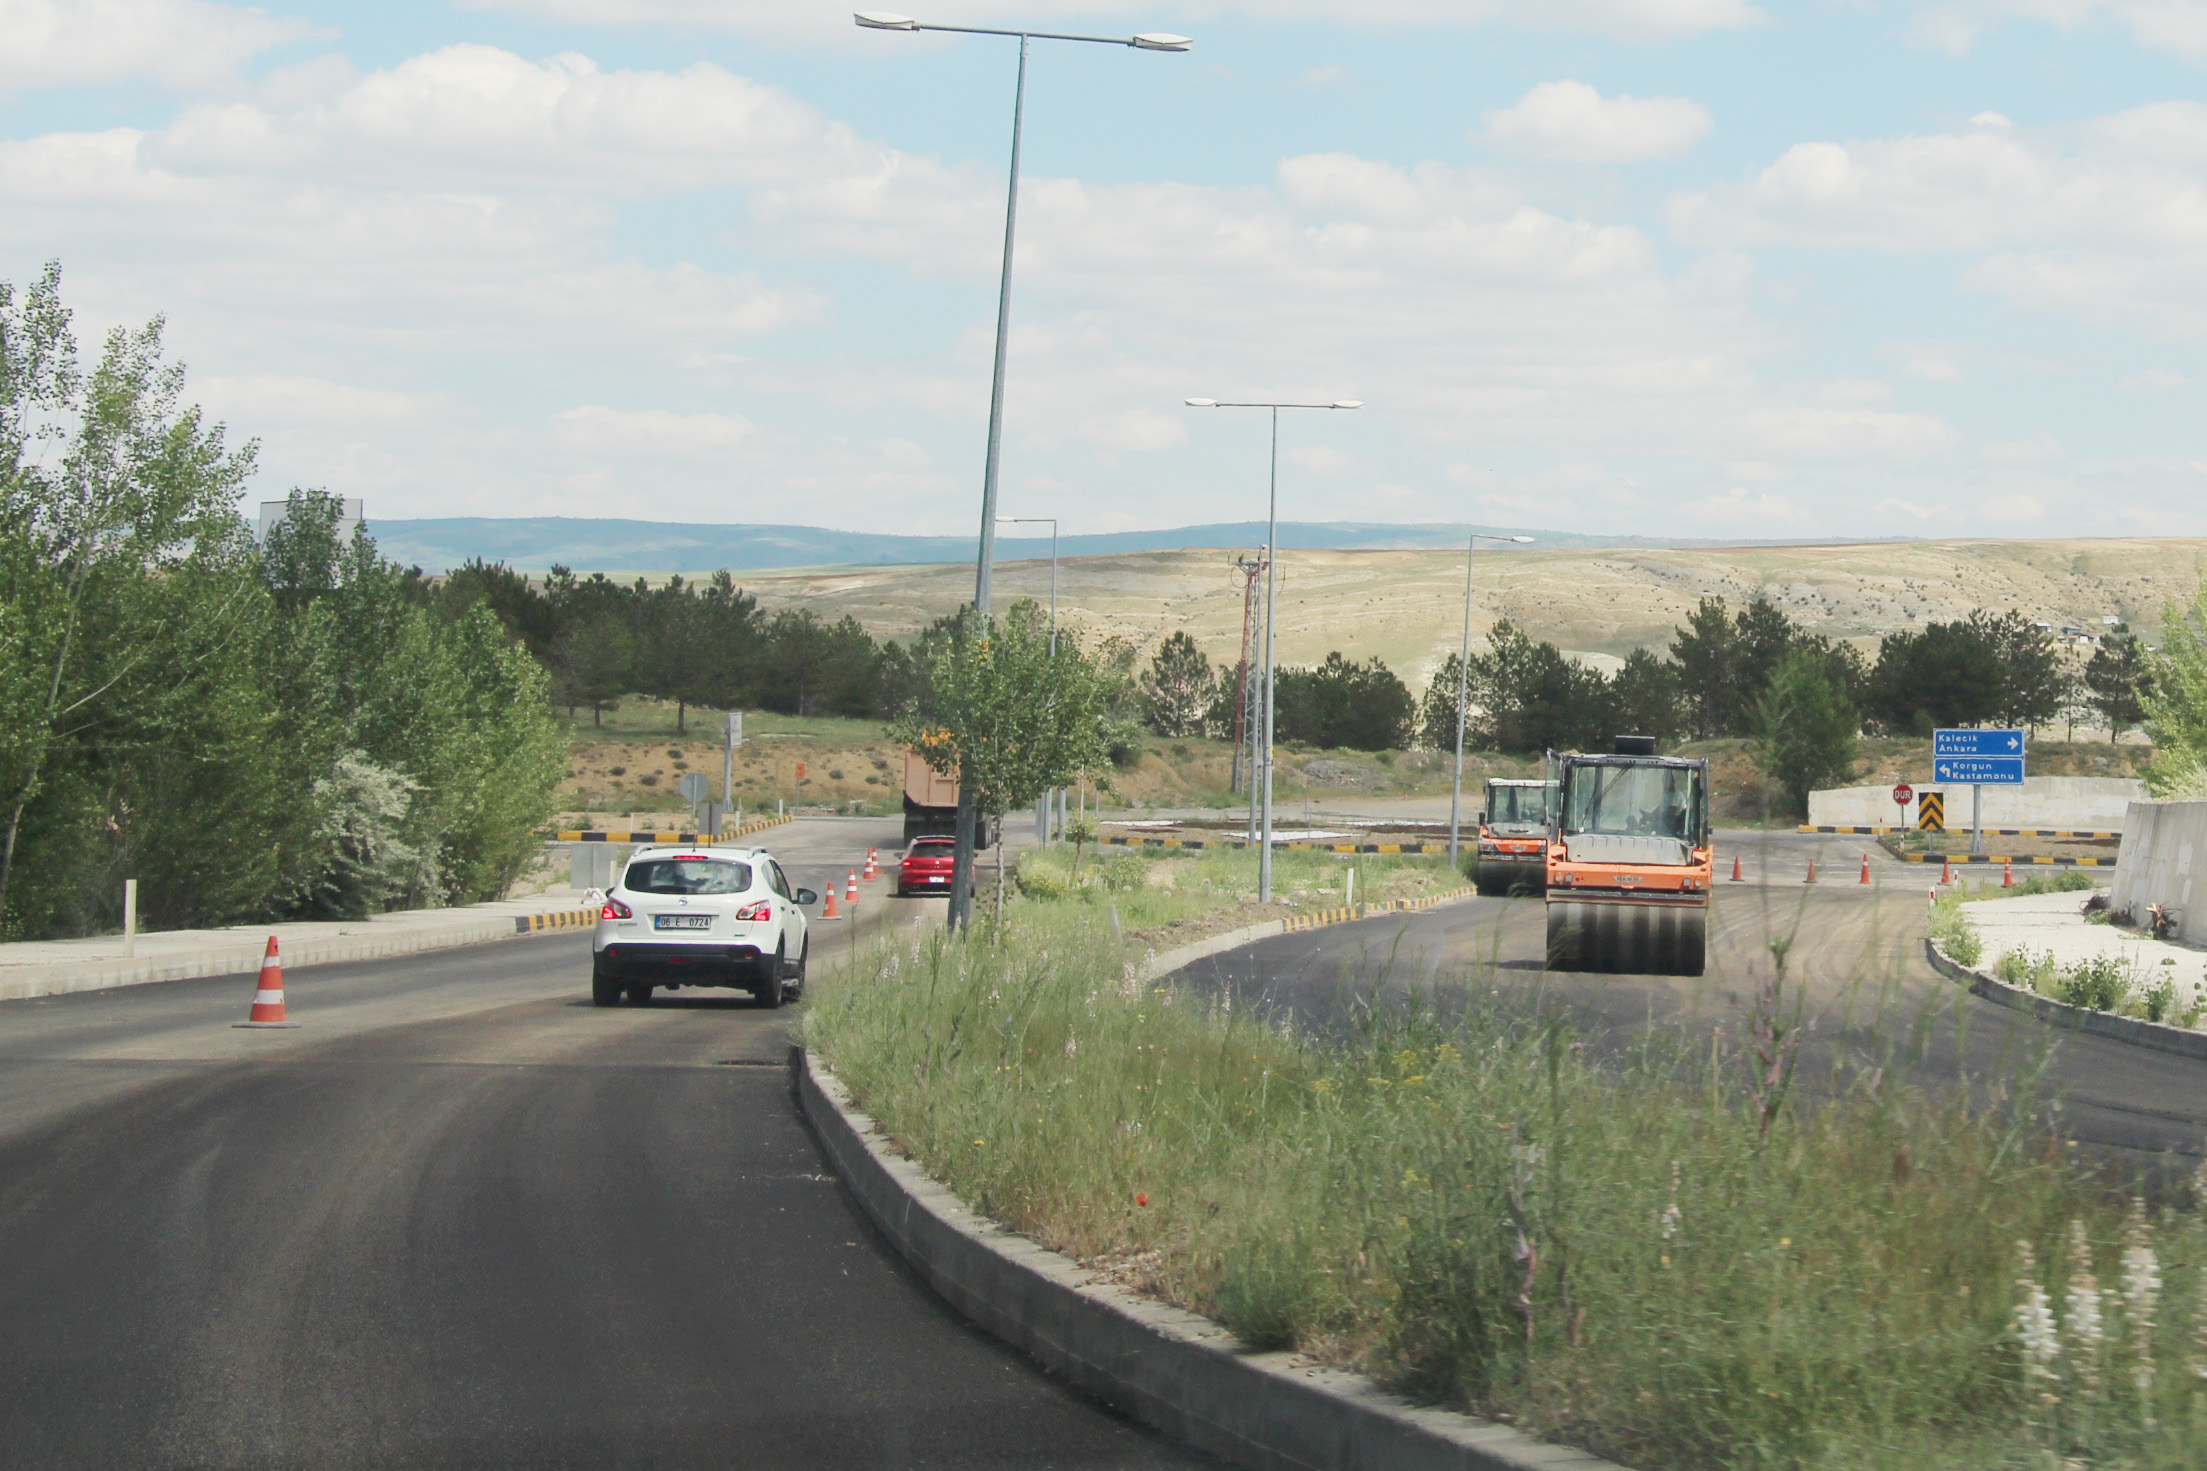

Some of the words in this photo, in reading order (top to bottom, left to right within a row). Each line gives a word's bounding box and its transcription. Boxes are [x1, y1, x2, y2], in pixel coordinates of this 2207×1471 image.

[1938, 734, 1978, 742] Kalecik
[1938, 744, 1977, 752] Ankara
[1952, 762, 1992, 771] Korgun
[1895, 790, 1911, 799] DUR
[660, 918, 670, 926] 06
[689, 918, 709, 926] 0724
